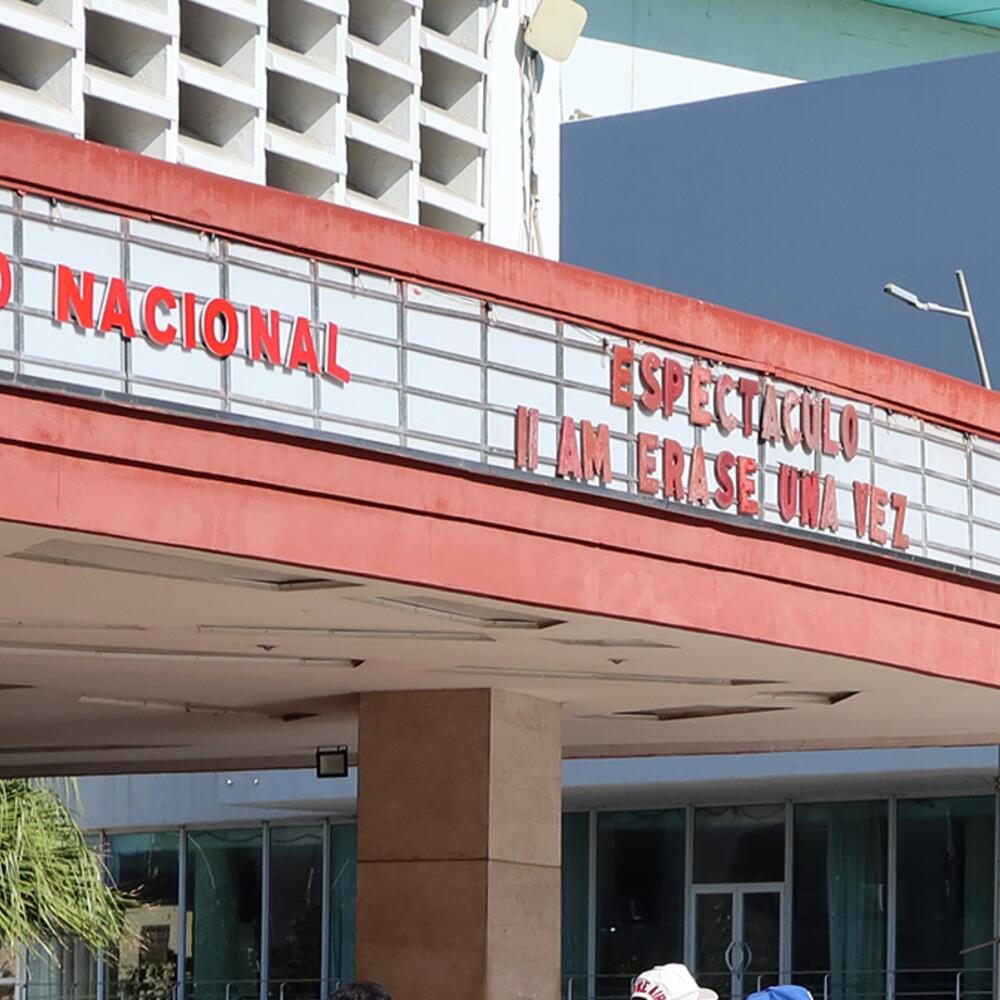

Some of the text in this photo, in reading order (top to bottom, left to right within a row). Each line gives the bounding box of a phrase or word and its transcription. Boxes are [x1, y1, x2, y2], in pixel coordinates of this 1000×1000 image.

[56, 264, 350, 384] NACIONAL
[609, 345, 858, 460] ESPECTACULO
[557, 416, 612, 483] AM
[637, 432, 759, 516] ERASE
[778, 463, 838, 533] UNA
[853, 480, 910, 549] VEZ
